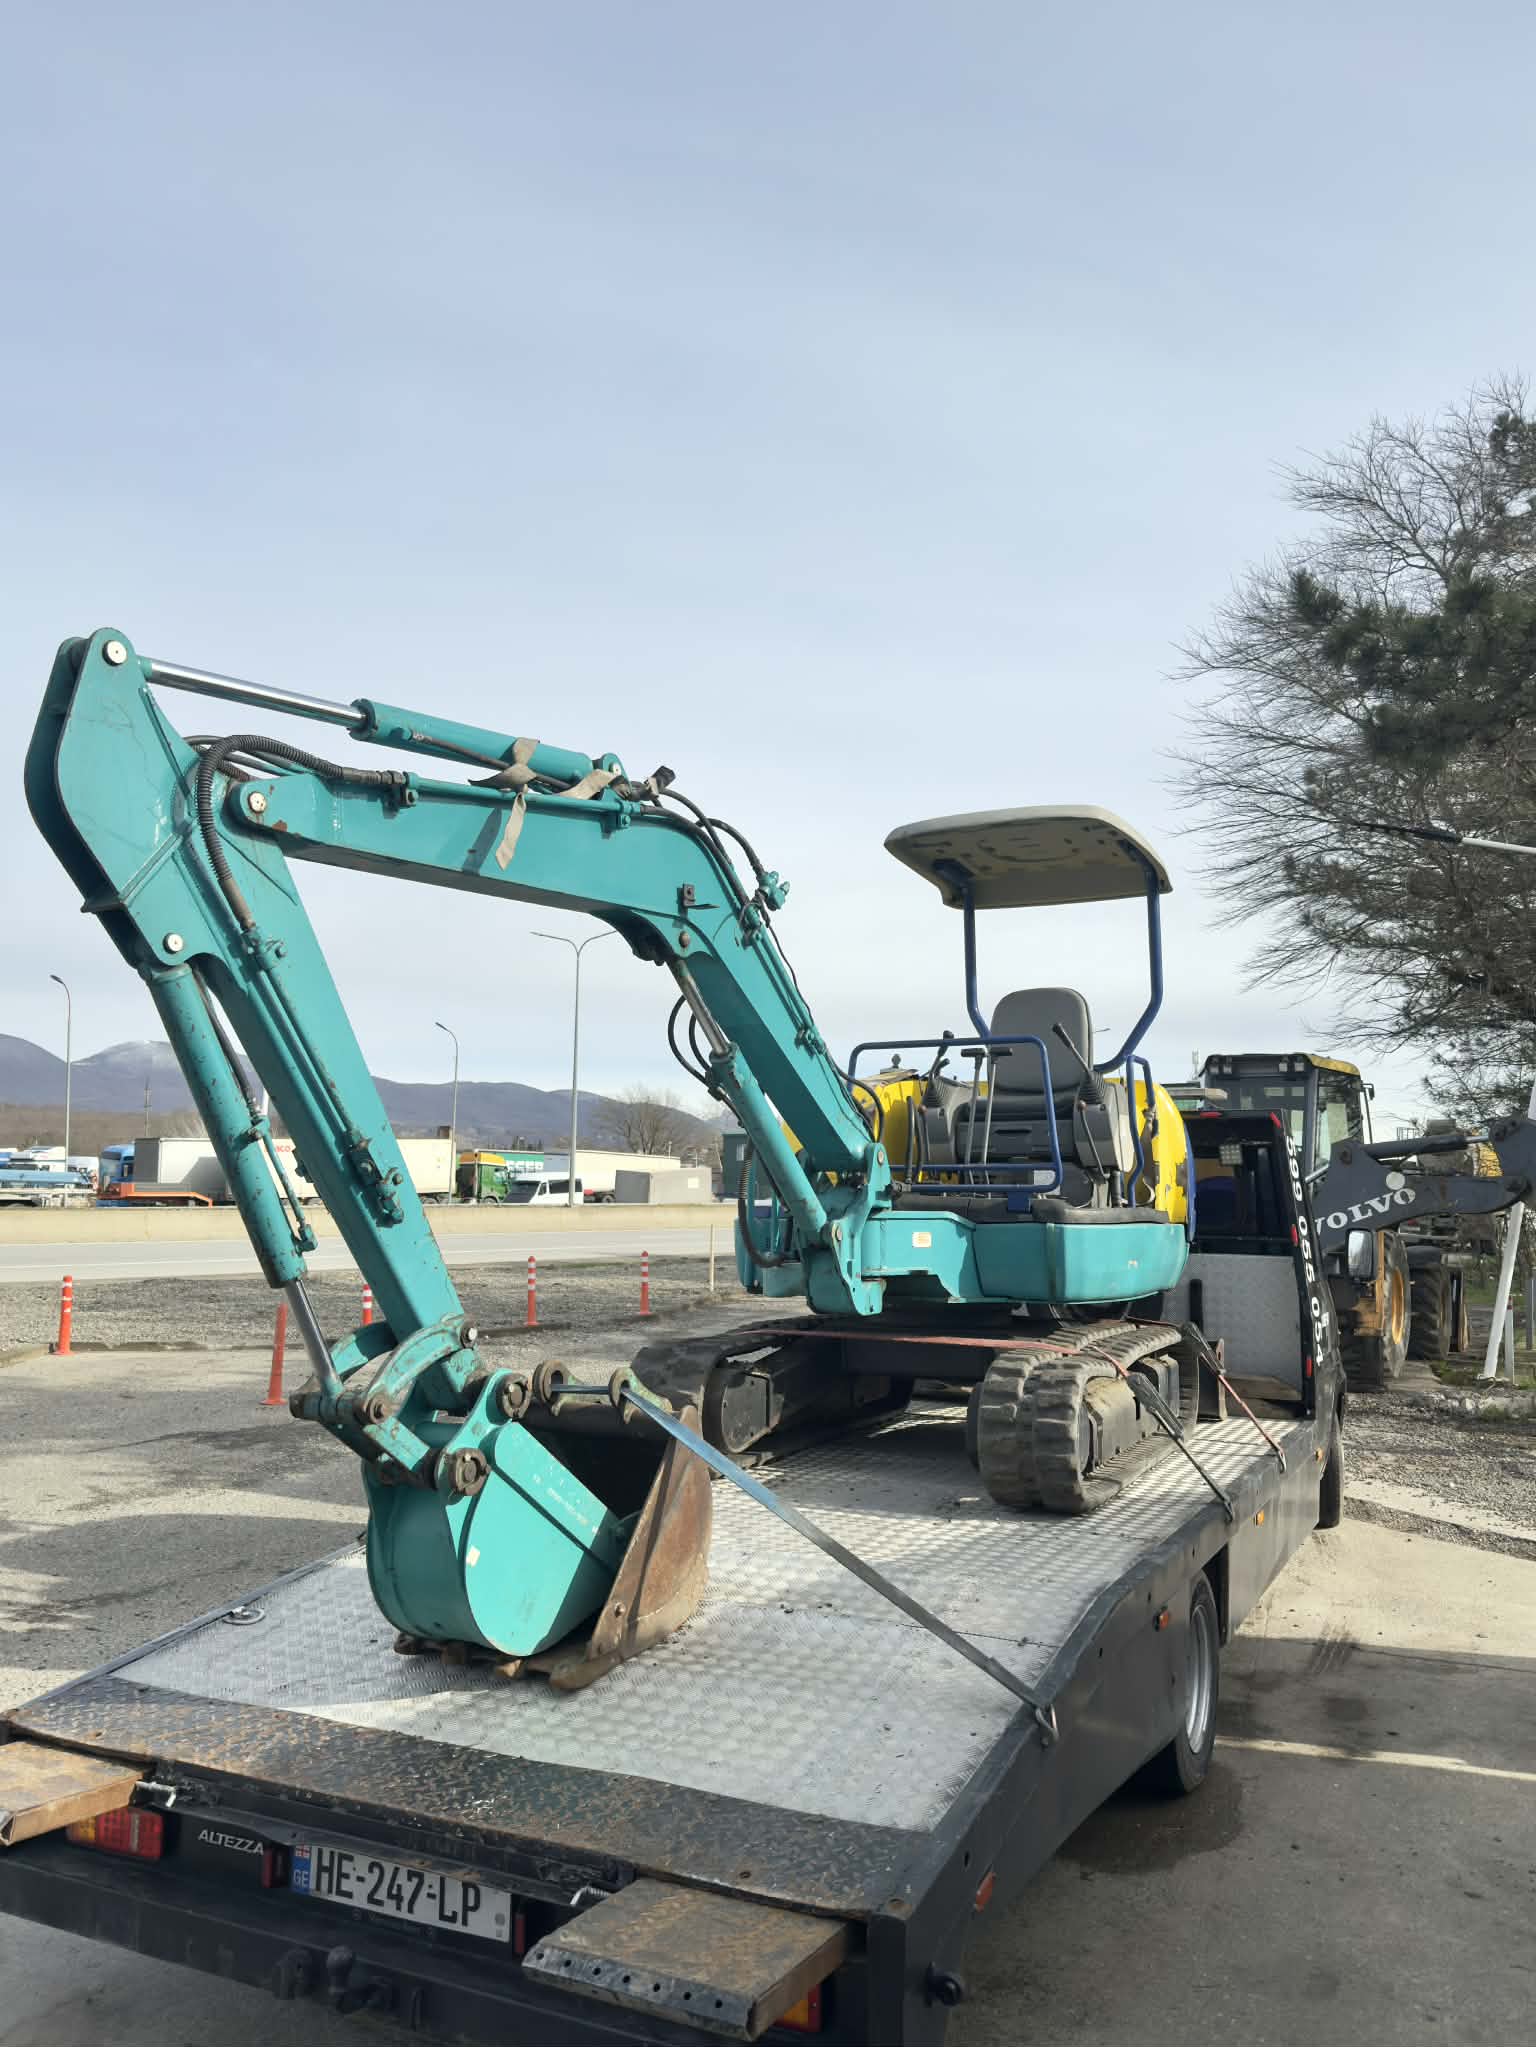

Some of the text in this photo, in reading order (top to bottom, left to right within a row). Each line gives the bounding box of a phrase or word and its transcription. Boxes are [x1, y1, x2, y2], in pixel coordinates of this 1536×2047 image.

[1286, 1136, 1324, 1367] 599 055 054
[198, 1829, 264, 1855] ALTEZZA
[292, 1869, 310, 1889] GE
[315, 1847, 482, 1927] HE-247-LP
